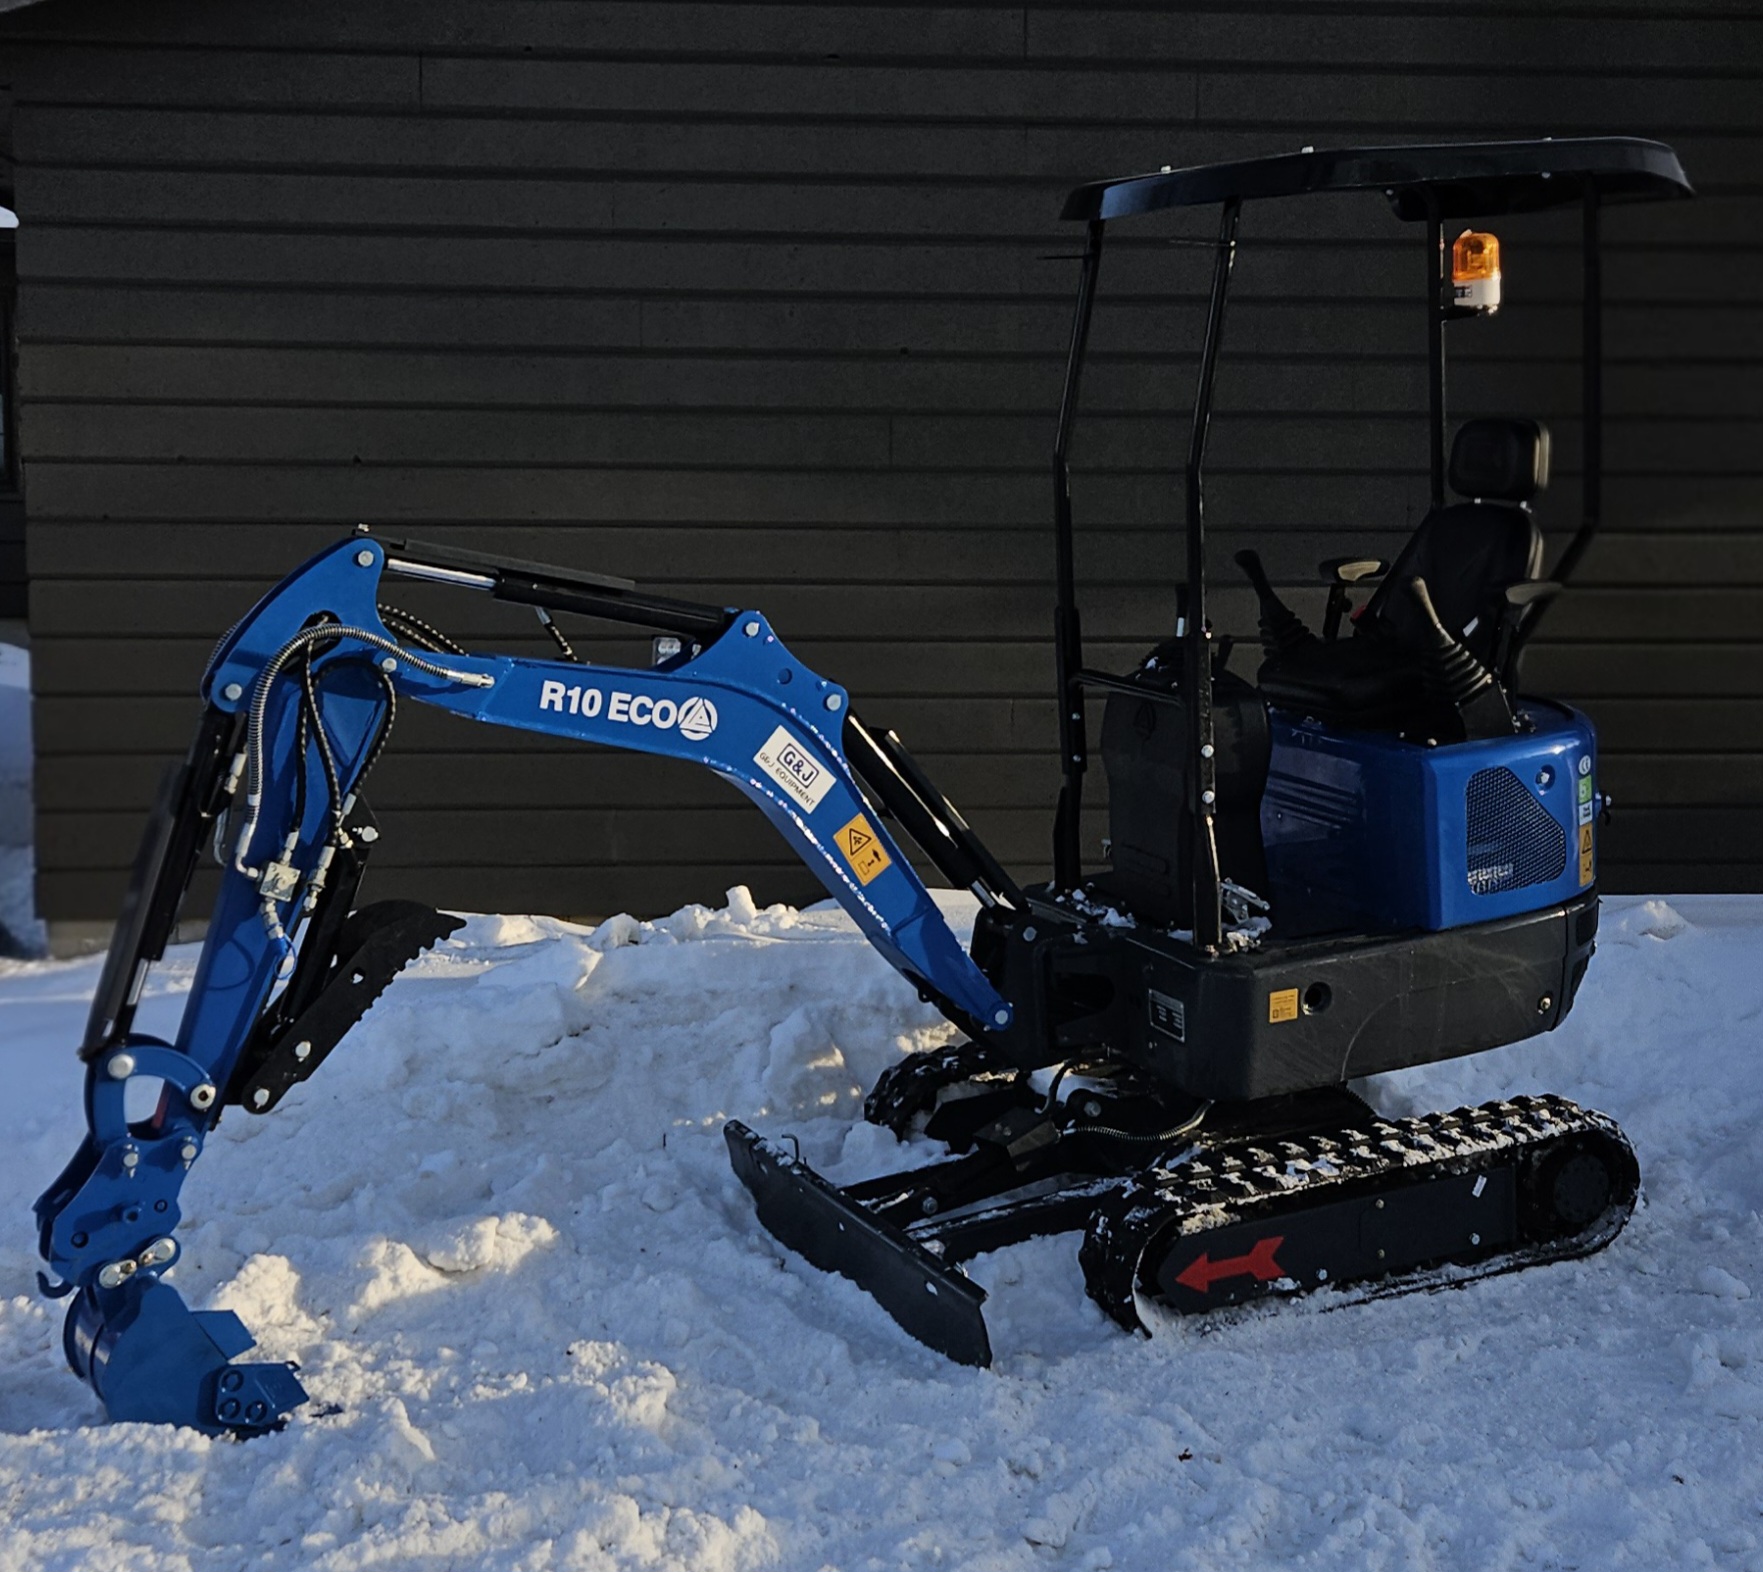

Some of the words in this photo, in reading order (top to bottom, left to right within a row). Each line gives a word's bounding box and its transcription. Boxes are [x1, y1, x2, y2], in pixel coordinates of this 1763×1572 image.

[539, 680, 602, 717] R10
[607, 691, 678, 729] ECO
[759, 752, 775, 768] G&J
[775, 767, 815, 806] EQUIPMENT
[783, 750, 814, 782] G&J
